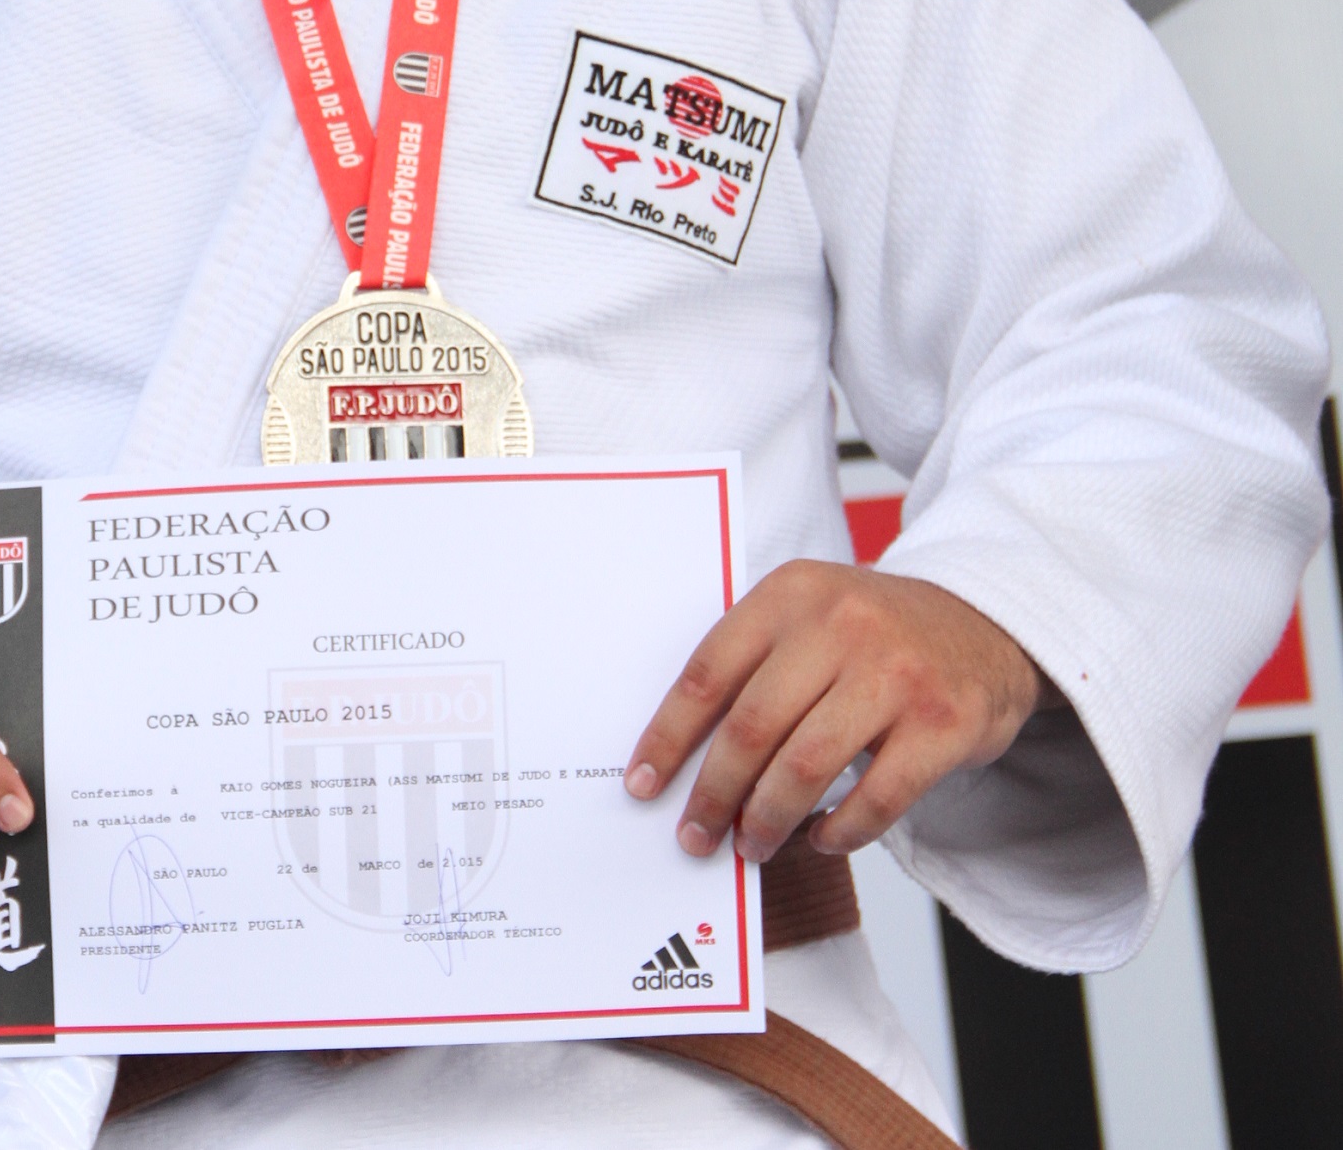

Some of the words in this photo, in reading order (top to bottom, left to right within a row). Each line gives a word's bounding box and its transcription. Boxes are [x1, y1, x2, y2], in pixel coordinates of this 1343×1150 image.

[291, 8, 332, 92] PAULISTA
[317, 93, 343, 118] DE
[584, 63, 771, 152] MATSUMI
[326, 121, 365, 169] JUDÔ
[580, 112, 644, 141] JUDÔ
[653, 132, 669, 150] E
[388, 121, 423, 226] FEDERAÇÃO
[579, 184, 618, 211] S.J.
[630, 198, 664, 224] Rio
[673, 213, 717, 245] Preto
[382, 228, 410, 288] PAULIS
[357, 311, 428, 345] COPA
[301, 342, 344, 375] SÃO
[353, 348, 423, 373] PAULO
[432, 346, 487, 372] 2015
[88, 505, 332, 541] FEDERAÇÃO
[89, 549, 281, 582] PAULISTA
[89, 595, 142, 621] DE
[148, 586, 259, 623] JUDÔ
[312, 631, 466, 654] CERTIFICADO
[146, 714, 200, 730] COPA
[212, 708, 250, 727] SÃO
[264, 707, 328, 724] PAULO
[342, 704, 392, 721] 2015
[71, 787, 154, 800] Conferimos
[220, 782, 253, 793] KAIO
[261, 779, 302, 791] GOMES
[311, 777, 377, 789] NOGUEIRA
[387, 775, 418, 787] (ASS
[426, 773, 483, 785] MATSUMI
[492, 771, 510, 782] DE
[517, 769, 551, 781] JUDO
[72, 817, 89, 828] na
[97, 814, 172, 829] qualidade
[179, 812, 196, 823] de
[221, 806, 320, 820] VICE-CAMPEÃO
[329, 806, 353, 817] SUB
[361, 805, 377, 815] 21
[451, 800, 486, 811] MEIO
[494, 798, 544, 810] PESADO
[153, 868, 178, 880] SÃO
[187, 867, 228, 878] PAULO
[276, 864, 293, 875] 22
[301, 863, 318, 874] de
[417, 859, 434, 870] de
[79, 924, 172, 938] ALESSANDRO
[247, 919, 304, 931] PUGLIA
[404, 913, 441, 925] JOJI
[450, 910, 508, 924] KIMURA
[80, 944, 161, 956] PRESIDENTE
[404, 929, 496, 943] COORDENADOR
[694, 938, 716, 946] MKS
[632, 969, 714, 991] adidas
